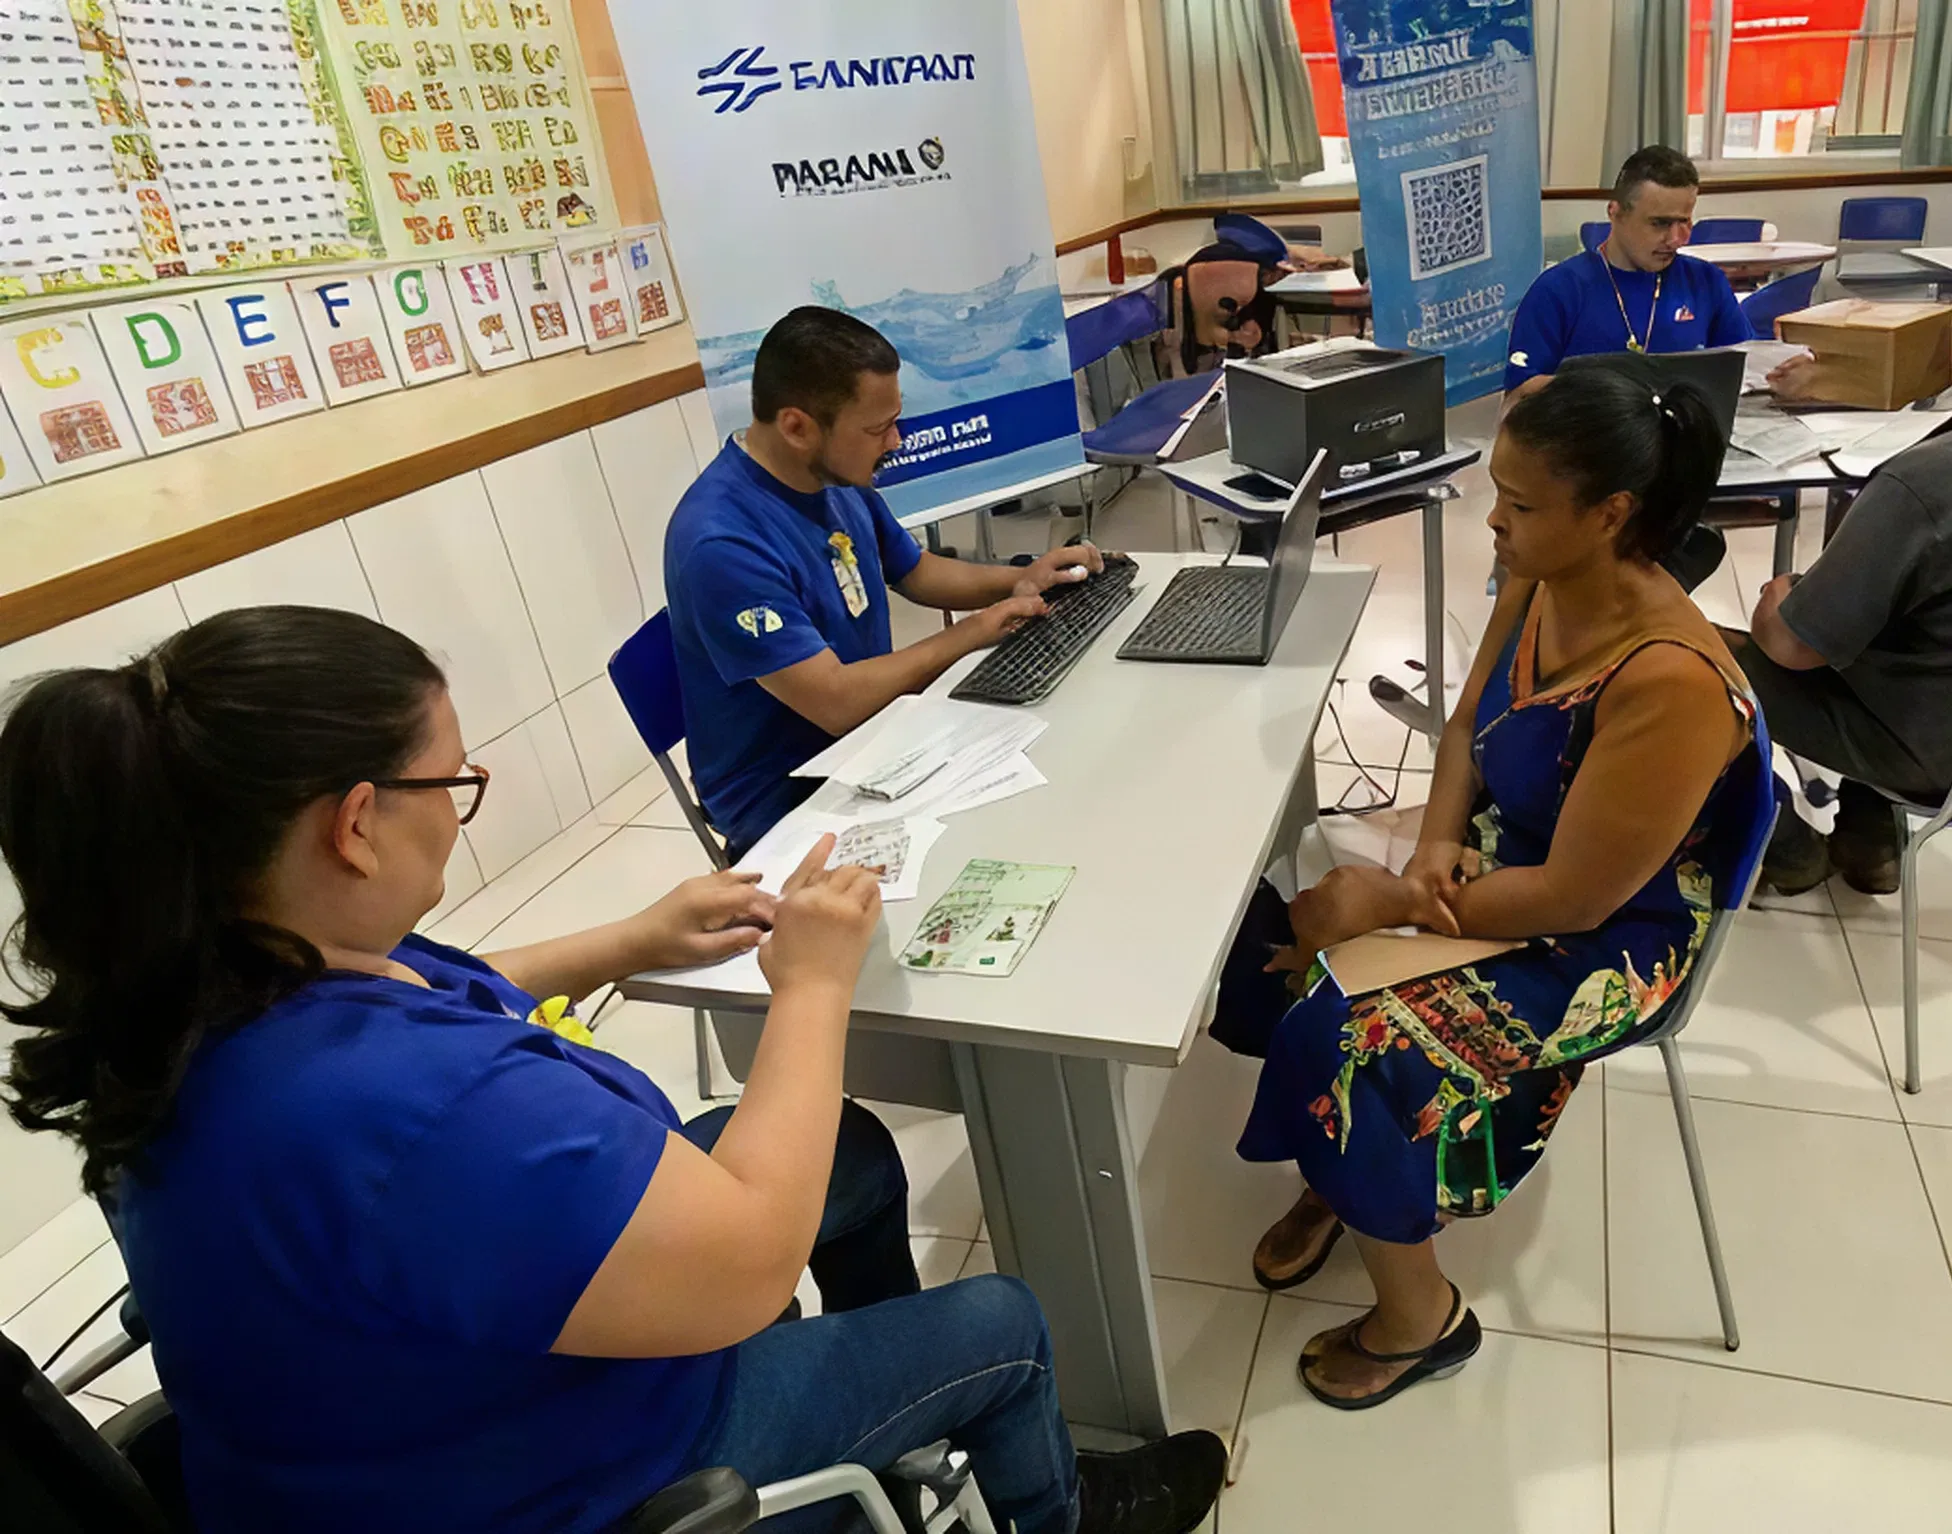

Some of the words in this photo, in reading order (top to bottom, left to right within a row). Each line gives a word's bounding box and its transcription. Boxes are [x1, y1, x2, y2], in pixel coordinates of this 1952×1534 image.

[15, 327, 81, 389] C
[125, 312, 181, 368] D
[225, 295, 275, 347] E
[315, 282, 349, 328] F
